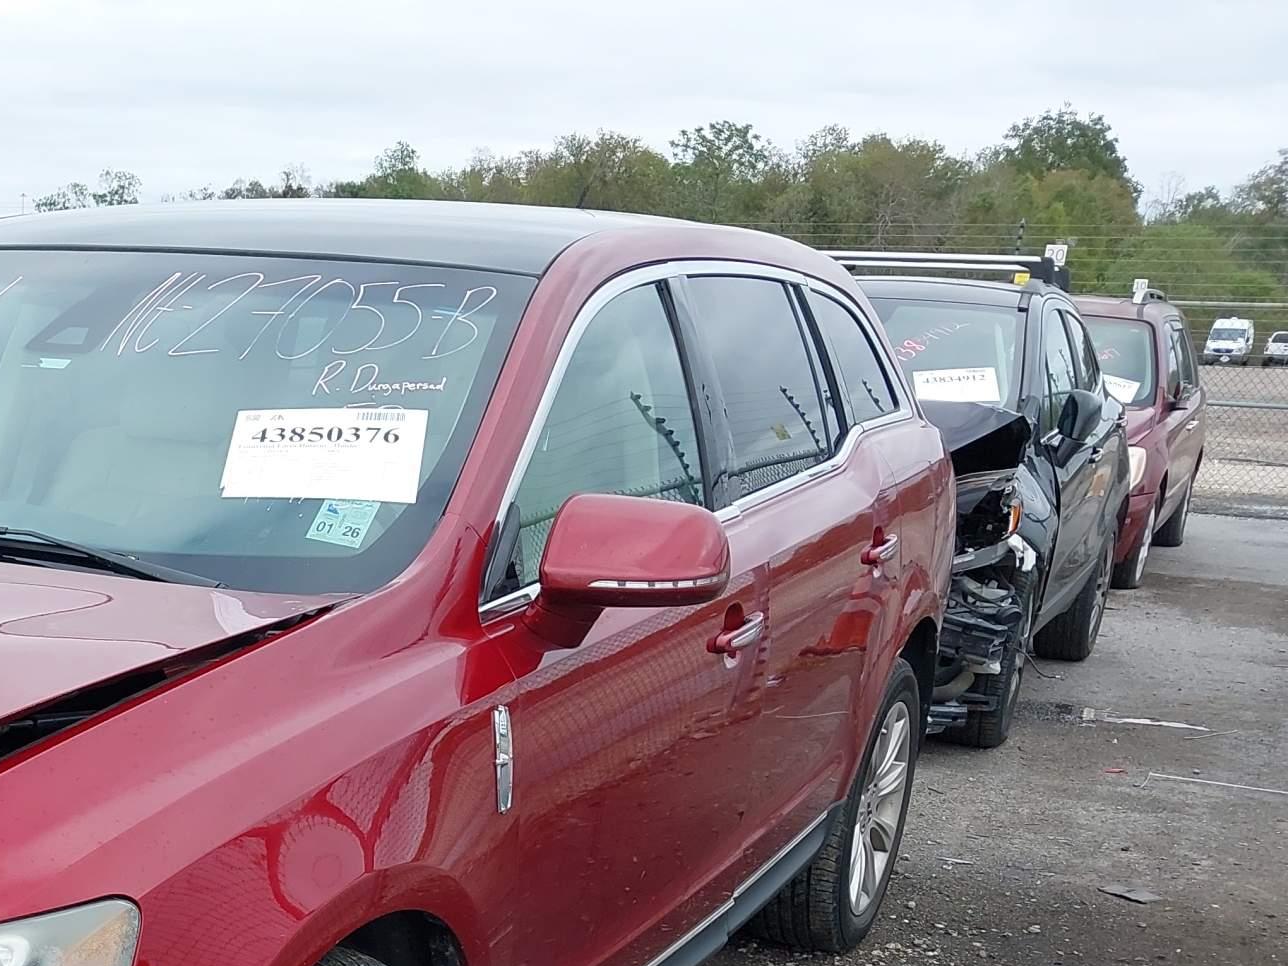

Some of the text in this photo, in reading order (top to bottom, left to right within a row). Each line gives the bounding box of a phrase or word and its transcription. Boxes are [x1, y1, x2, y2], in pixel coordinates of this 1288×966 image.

[1047, 248, 1065, 262] 20
[251, 425, 401, 445] 43850376
[315, 520, 361, 539] 01 26
